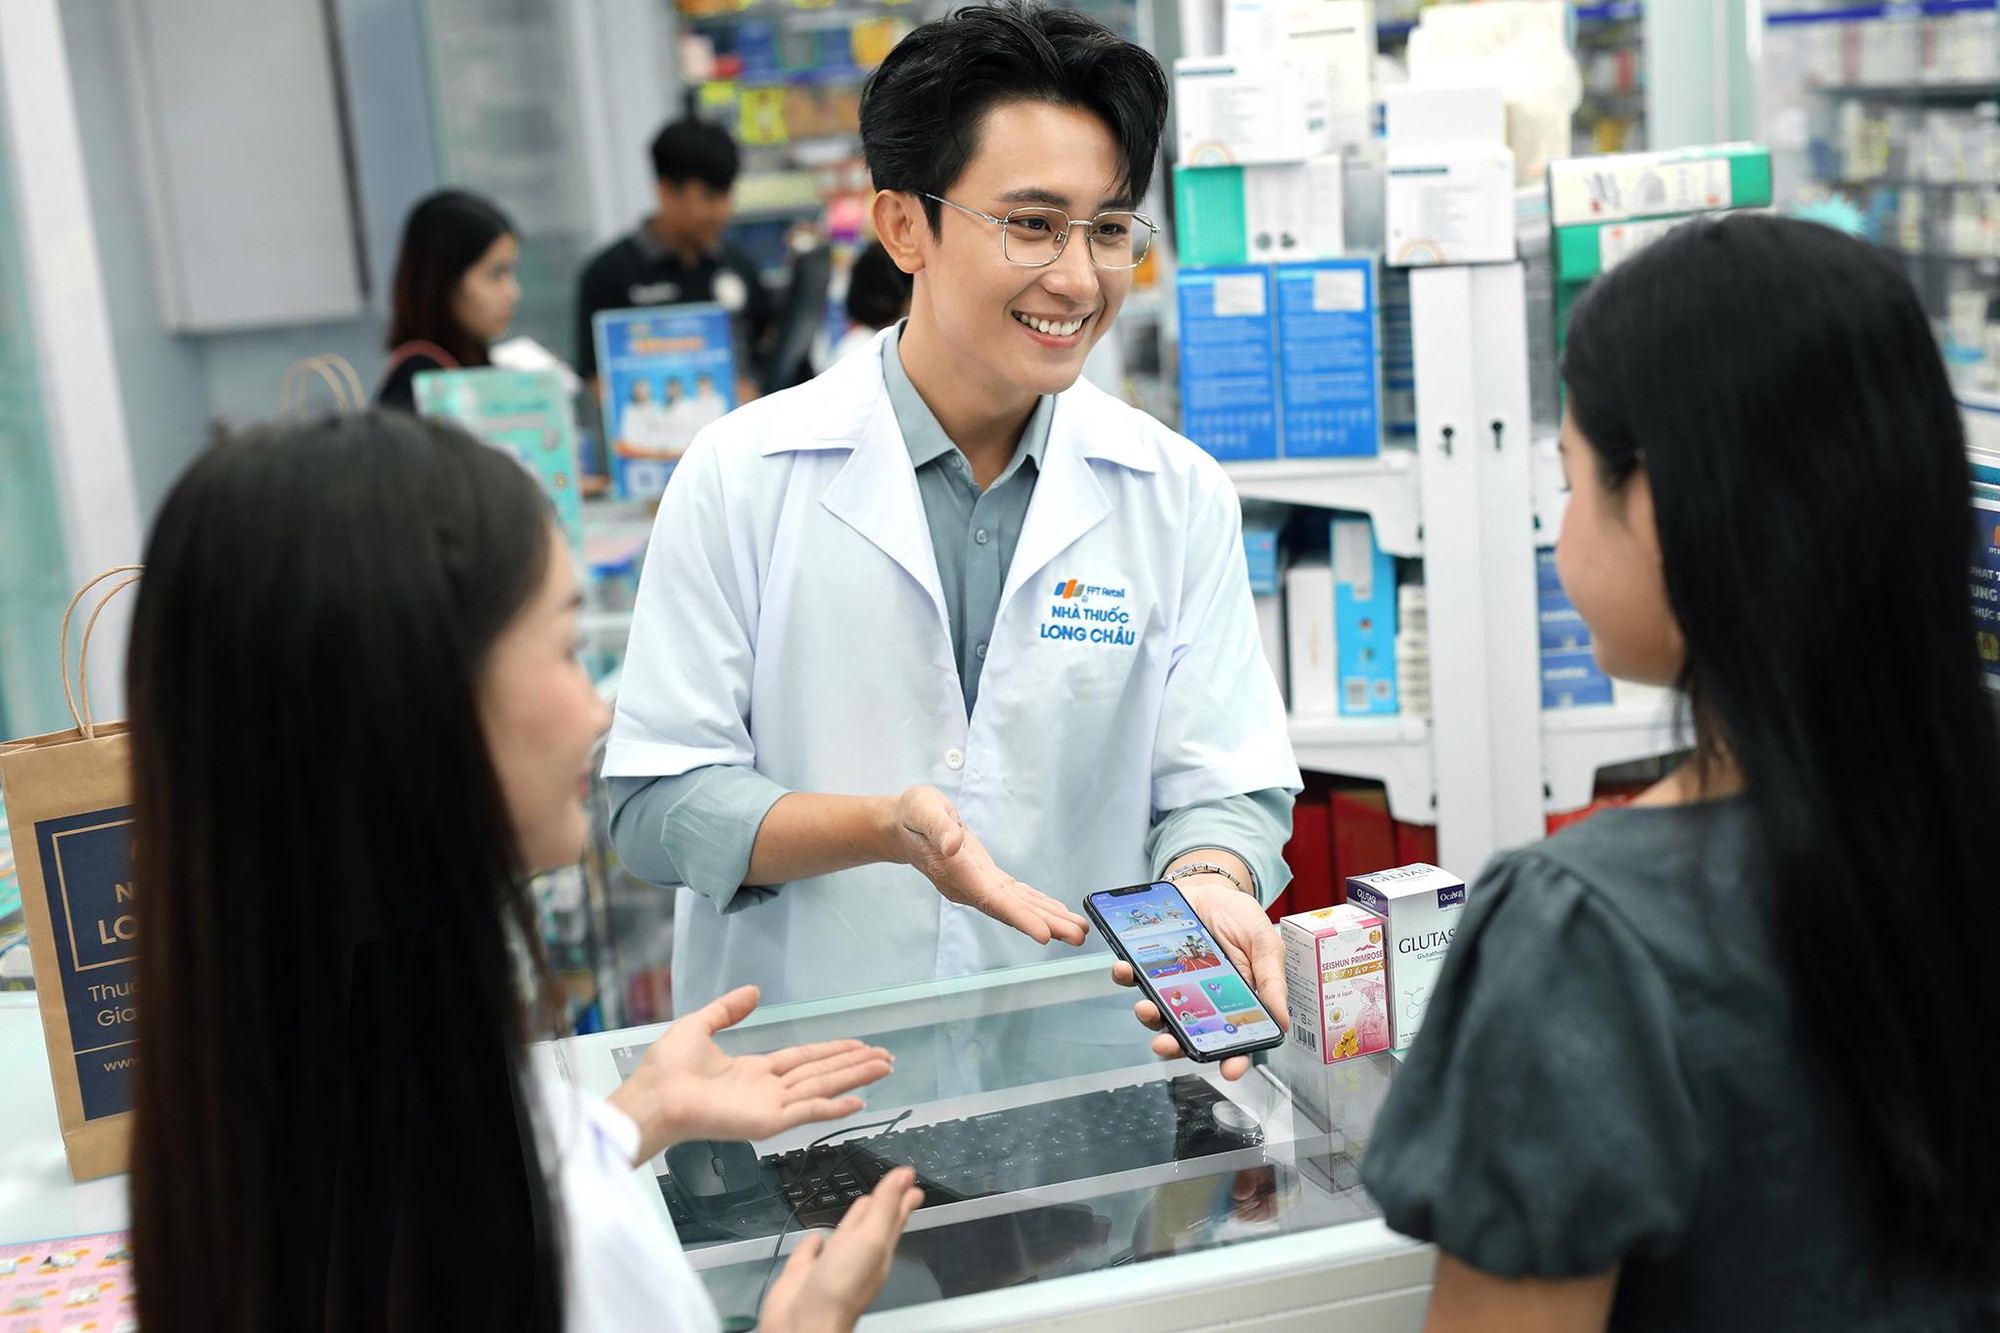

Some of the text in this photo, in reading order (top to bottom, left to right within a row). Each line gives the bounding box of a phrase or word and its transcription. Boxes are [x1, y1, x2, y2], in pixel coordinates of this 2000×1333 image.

[1087, 586, 1125, 598] FPT Retail
[1052, 604, 1129, 623] NHÀ THUỐC
[1041, 624, 1135, 645] LONG CHÂU
[97, 914, 139, 945] LO
[1398, 928, 1455, 954] GLUTAS
[1322, 949, 1384, 972] SEISHUN PRIMROSE
